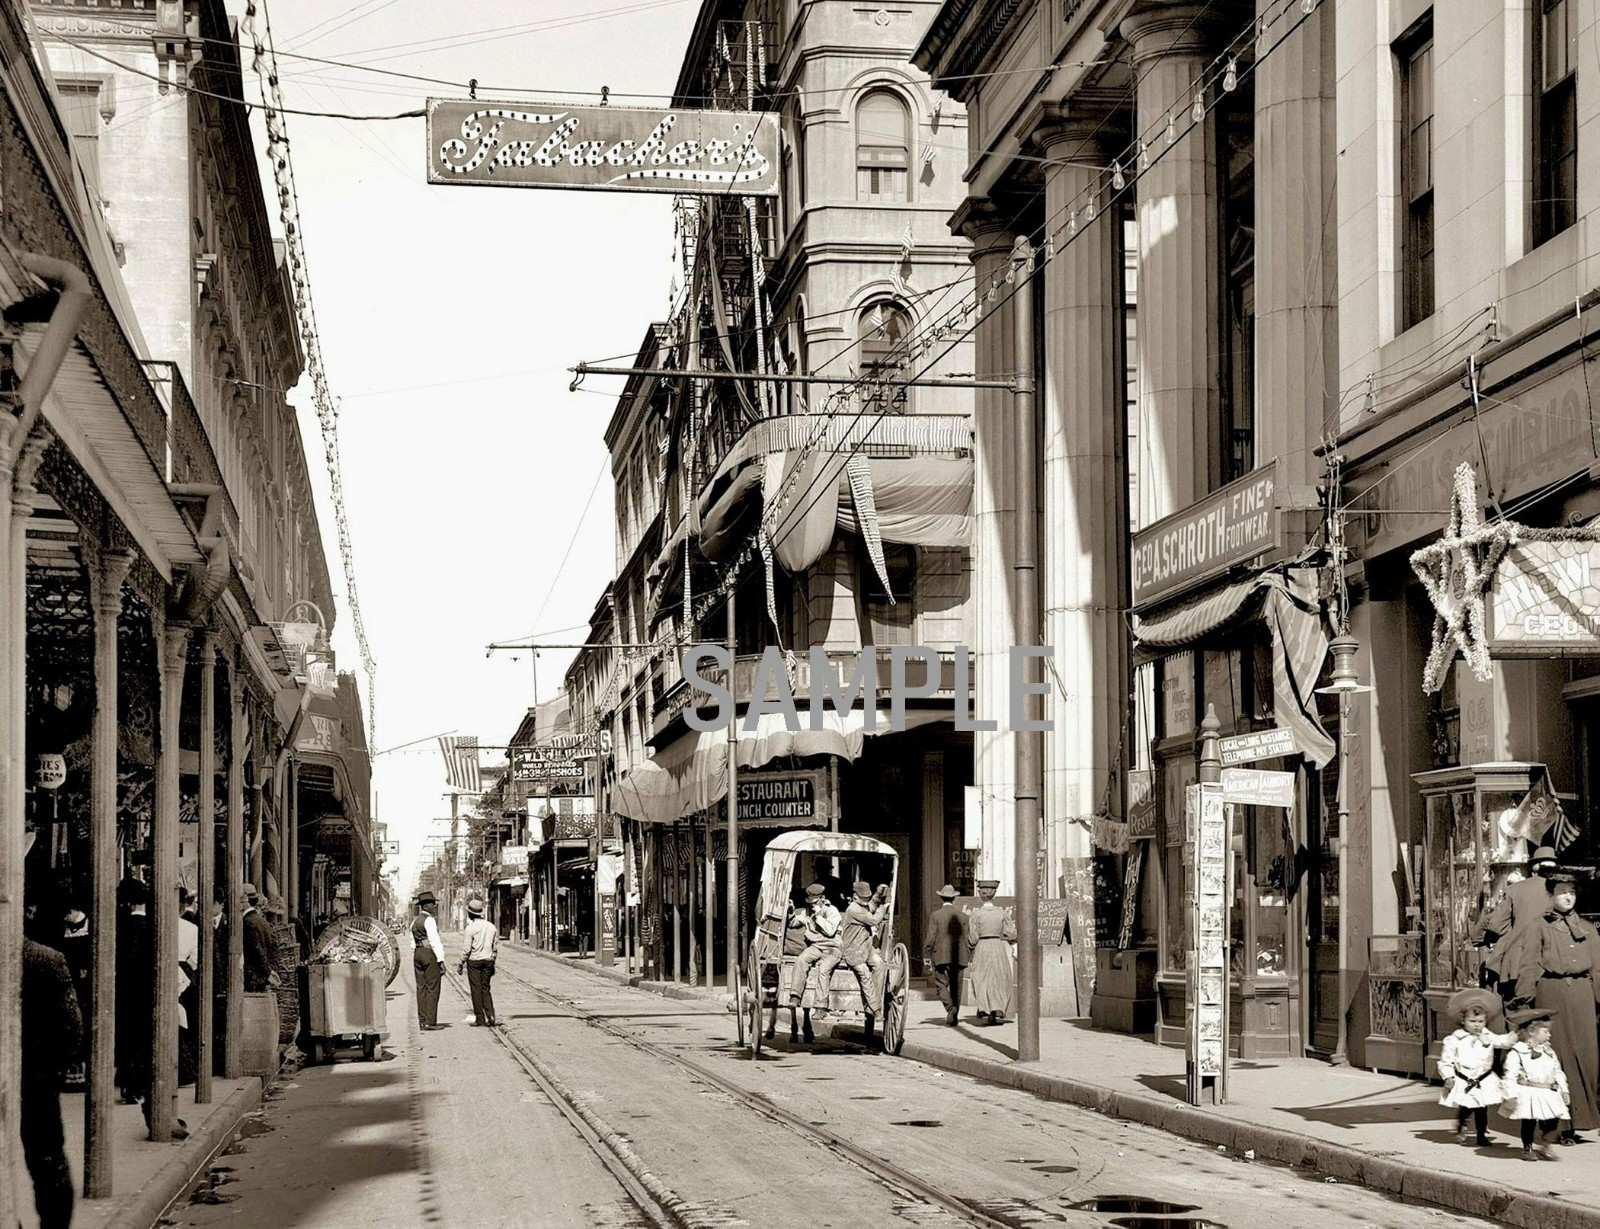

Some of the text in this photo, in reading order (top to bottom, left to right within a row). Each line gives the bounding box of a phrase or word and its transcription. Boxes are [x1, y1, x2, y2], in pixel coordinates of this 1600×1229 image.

[1163, 506, 1226, 578] SCHROTH
[1220, 739, 1239, 752] LOCAL
[1260, 730, 1292, 744] DISTANCE
[1222, 748, 1257, 763] TELEPHONE
[1268, 741, 1294, 755] STATION
[736, 780, 808, 802] ESTAURANT
[738, 803, 762, 819] UNCH
[764, 801, 812, 817] COUNTER
